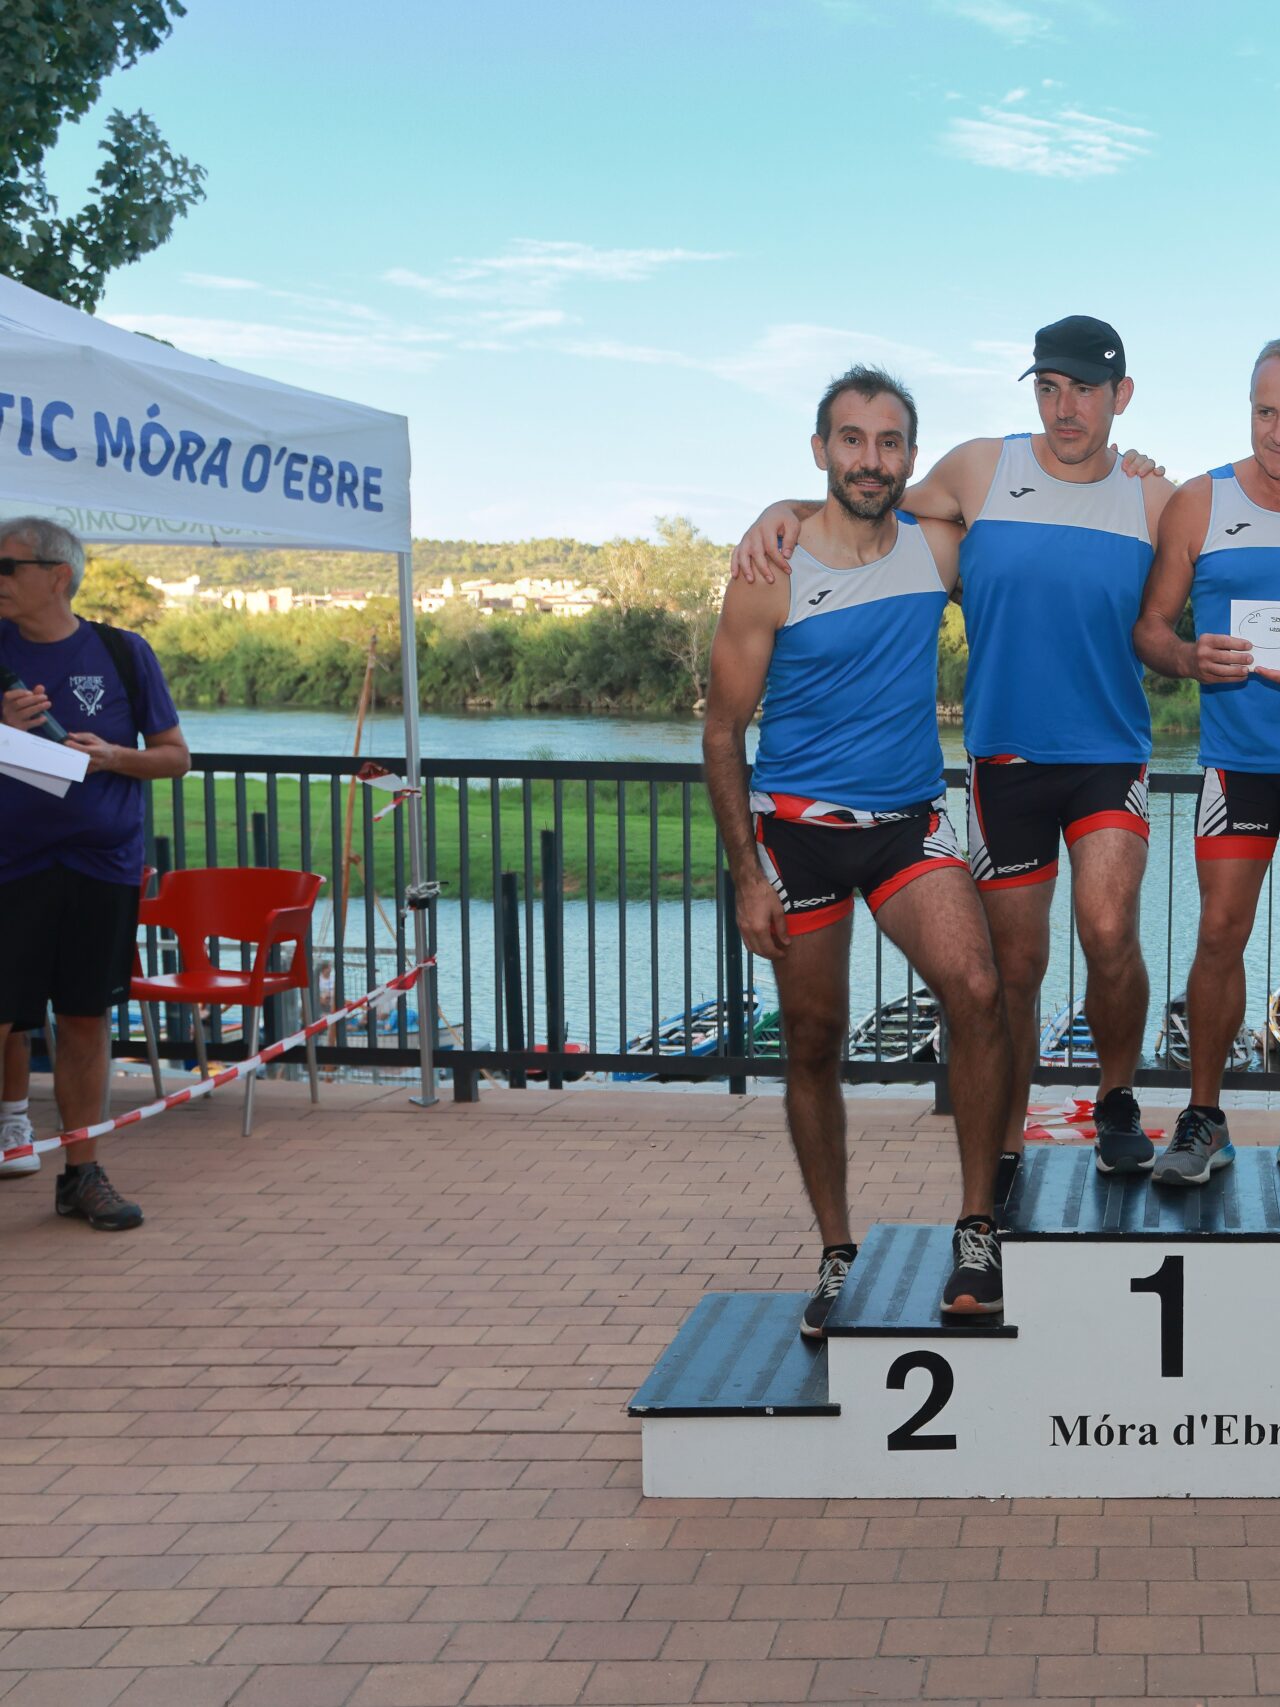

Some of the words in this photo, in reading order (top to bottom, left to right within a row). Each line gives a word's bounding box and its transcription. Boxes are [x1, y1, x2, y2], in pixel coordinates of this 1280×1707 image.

[1131, 1256, 1184, 1378] 1
[886, 1351, 957, 1451] 2
[1050, 1414, 1159, 1447] Móra
